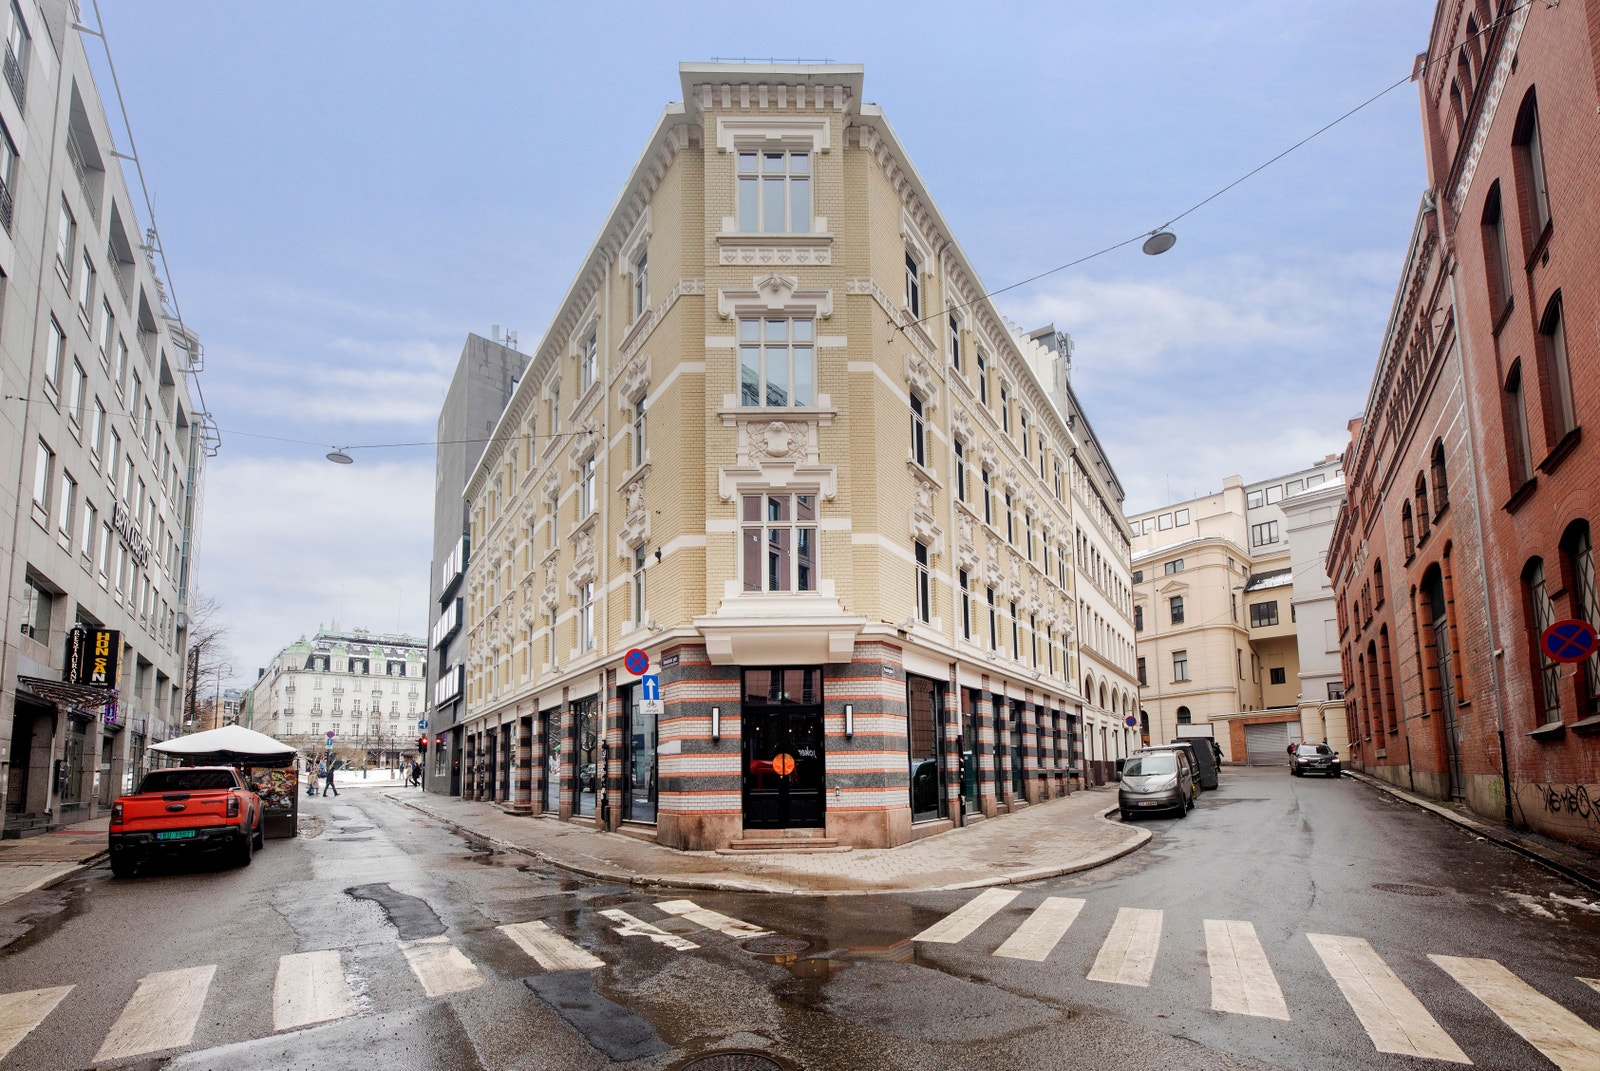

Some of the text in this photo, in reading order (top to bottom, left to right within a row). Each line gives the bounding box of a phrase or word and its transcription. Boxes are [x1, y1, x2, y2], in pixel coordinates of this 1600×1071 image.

[95, 632, 110, 656] HON
[70, 630, 80, 684] RESTAURANT
[91, 658, 107, 682] SAN
